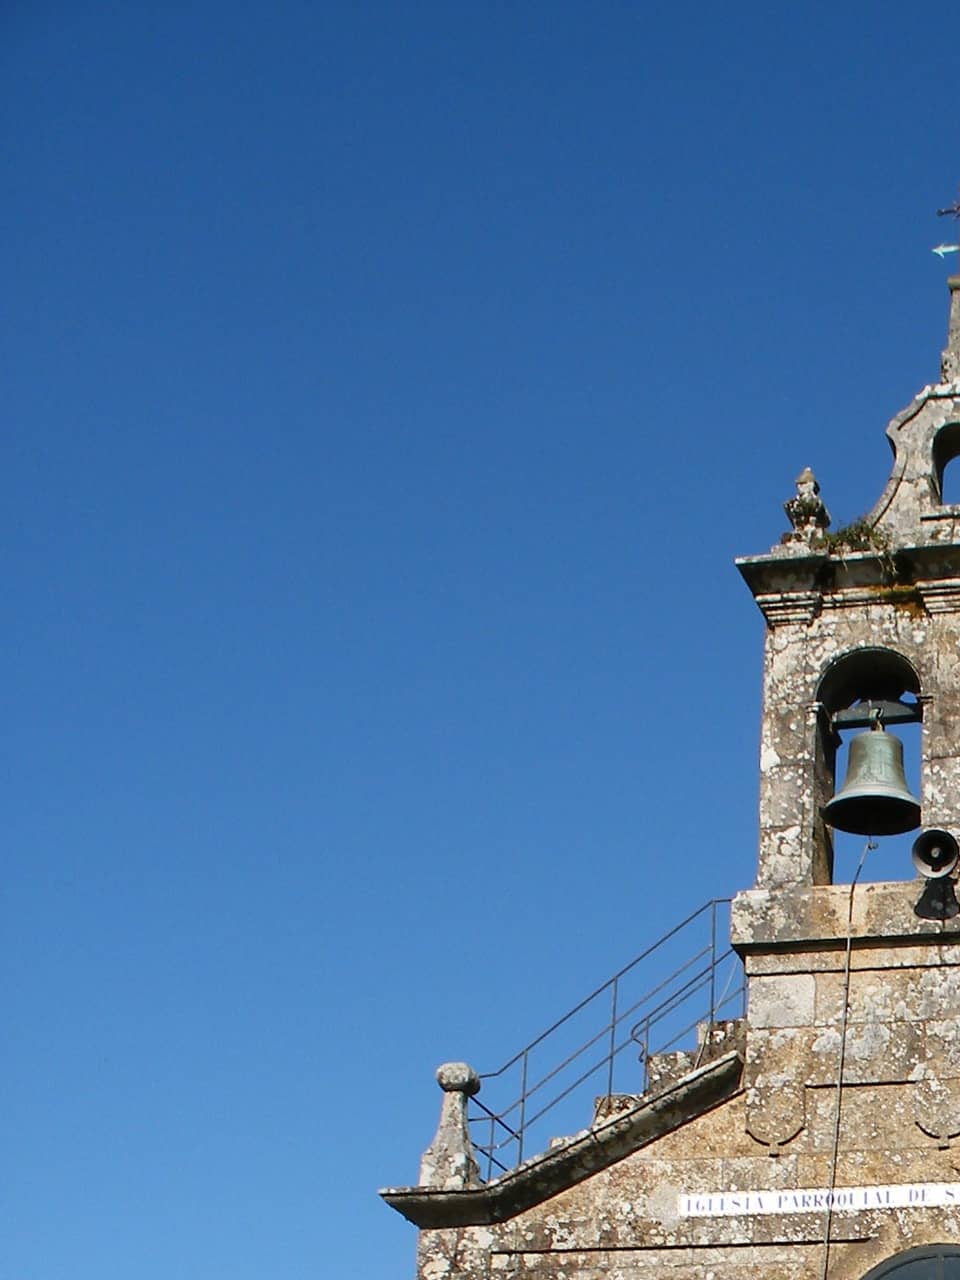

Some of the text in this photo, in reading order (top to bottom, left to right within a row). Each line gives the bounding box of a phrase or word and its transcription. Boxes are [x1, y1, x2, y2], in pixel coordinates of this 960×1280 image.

[687, 1196, 764, 1212] IGLESIA
[777, 1191, 895, 1209] PARROQUIAL
[908, 1188, 930, 1202] DE
